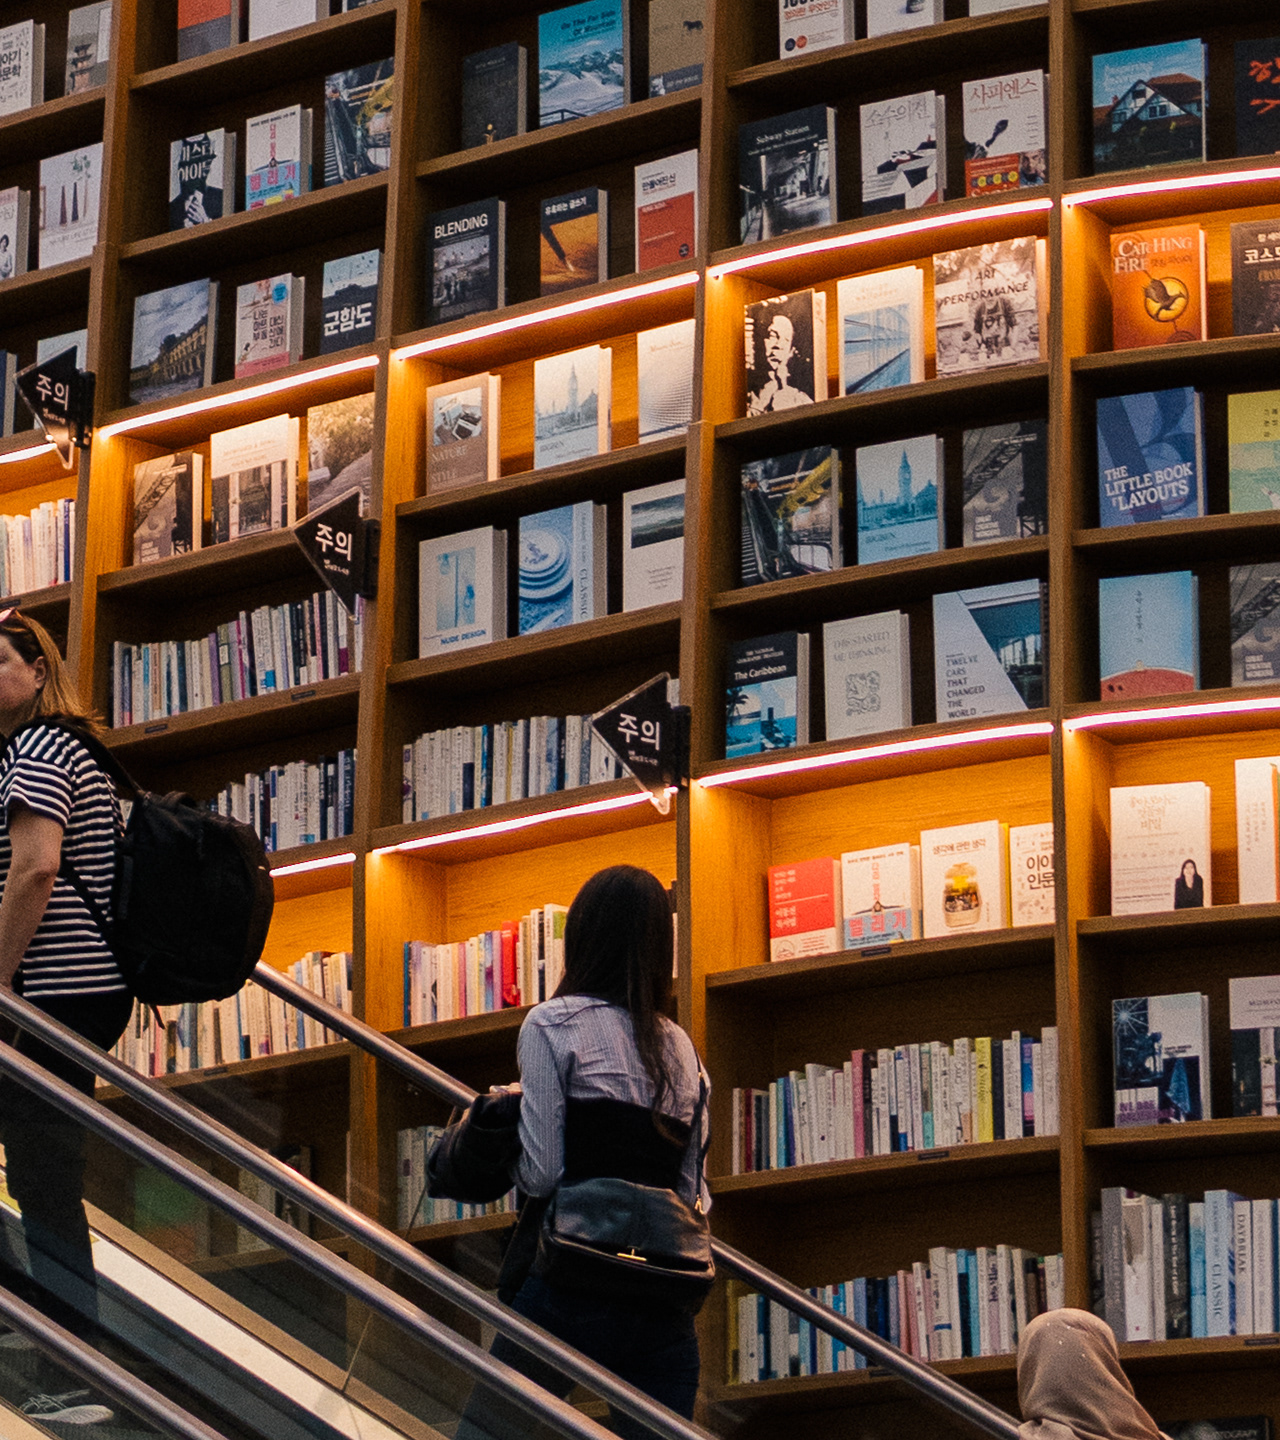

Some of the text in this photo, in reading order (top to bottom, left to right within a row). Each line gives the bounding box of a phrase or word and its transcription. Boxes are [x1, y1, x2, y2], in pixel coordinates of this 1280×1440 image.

[970, 76, 1039, 104] 사피엔스
[433, 211, 489, 240] BLENDING
[1118, 233, 1194, 258] CATCHING
[1113, 253, 1149, 275] FIRE
[940, 280, 1029, 308] PERFORMANCE
[324, 301, 372, 336] 군함도
[36, 372, 71, 412] 주의
[1105, 465, 1129, 483] THE
[1105, 462, 1194, 499] LITTLE BOOK
[1118, 483, 1190, 512] LAYOUTS
[314, 522, 354, 564] 주의
[749, 663, 787, 679] Caribbean
[945, 654, 978, 667] TWELVE
[945, 667, 966, 678] CARS
[946, 677, 968, 689] THAT
[946, 685, 986, 699] CHANGED
[947, 699, 963, 710] THE
[947, 707, 977, 719] WORLD
[617, 710, 661, 753] 주의
[1237, 1214, 1248, 1275] DAYBREAK
